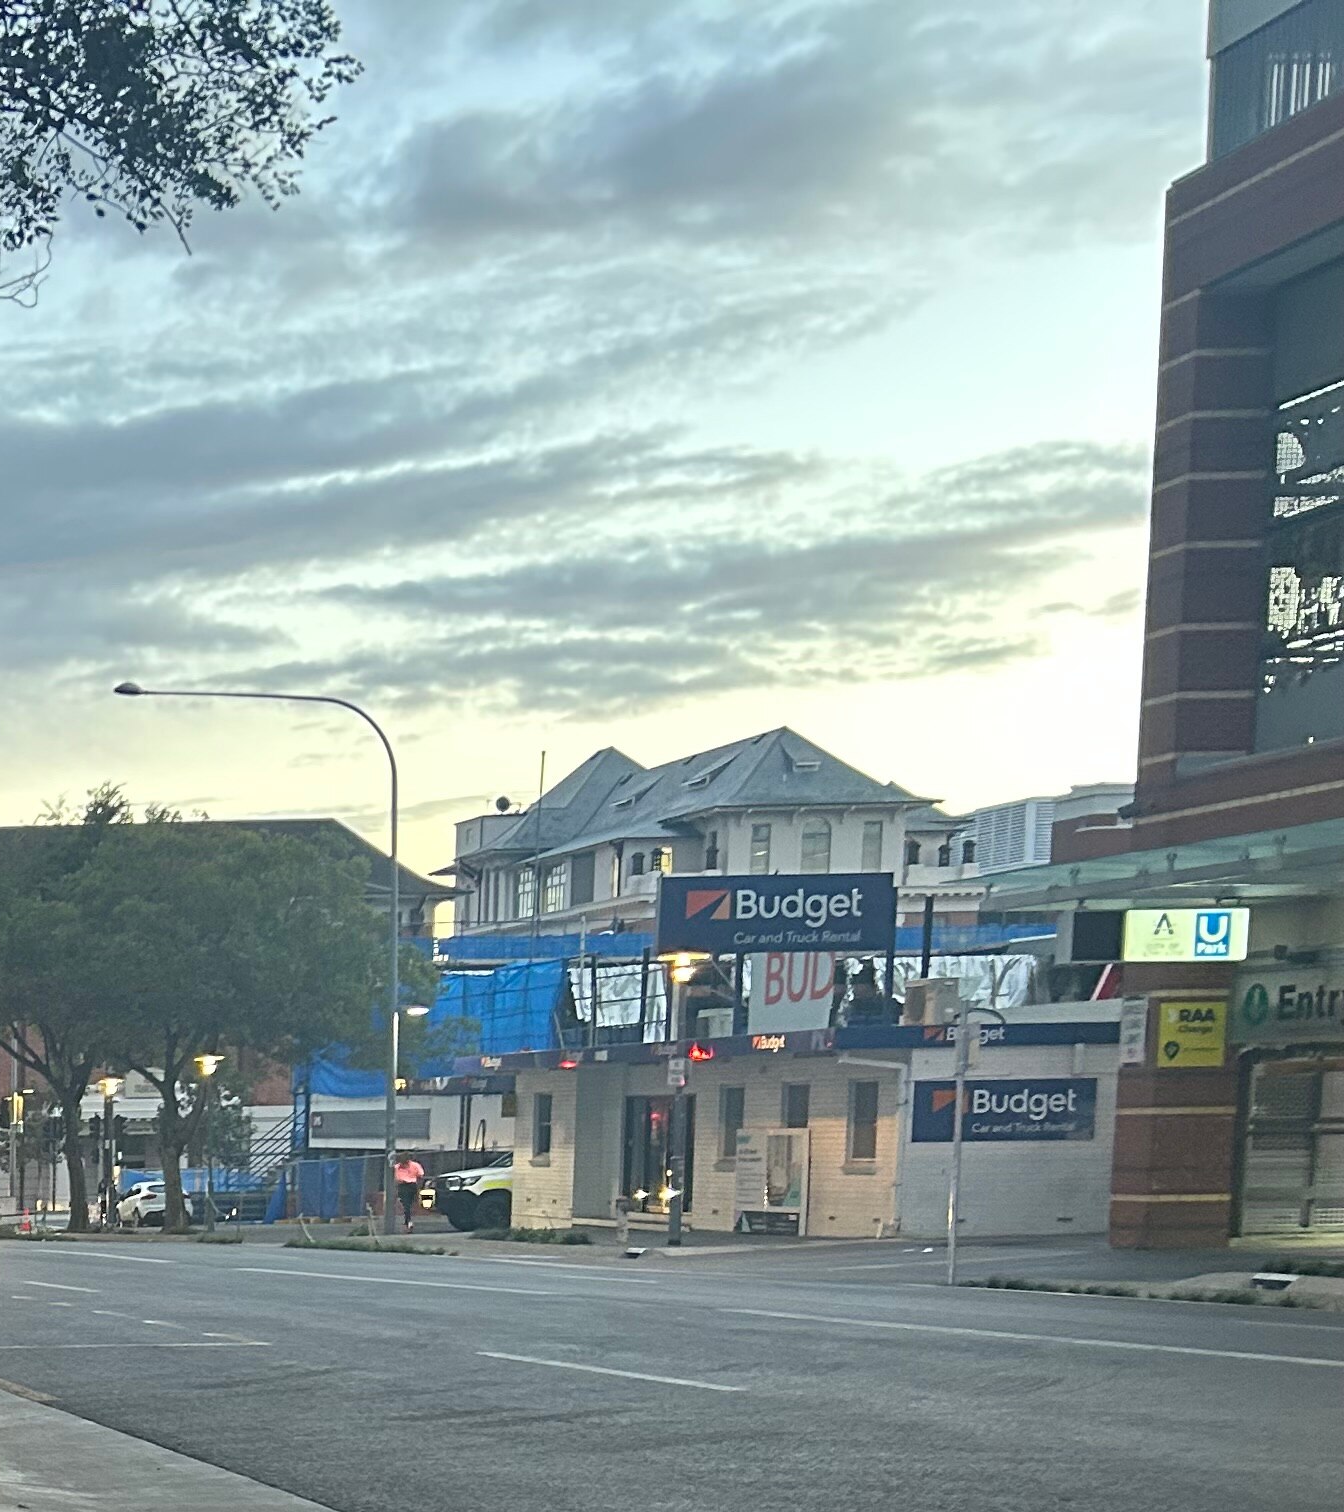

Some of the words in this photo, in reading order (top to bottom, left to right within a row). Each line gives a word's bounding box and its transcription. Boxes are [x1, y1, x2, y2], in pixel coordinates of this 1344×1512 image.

[735, 888, 863, 928] Budget
[733, 931, 757, 945] Car
[758, 931, 783, 944] and
[786, 930, 819, 943] Truck
[821, 929, 862, 943] Rental
[1199, 915, 1229, 943] U
[1196, 942, 1227, 954] Park
[764, 952, 837, 1006] BUD
[1178, 1008, 1215, 1022] RAA
[761, 1034, 786, 1053] Budget
[946, 1026, 1006, 1045] Bget
[972, 1088, 1078, 1121] Budget
